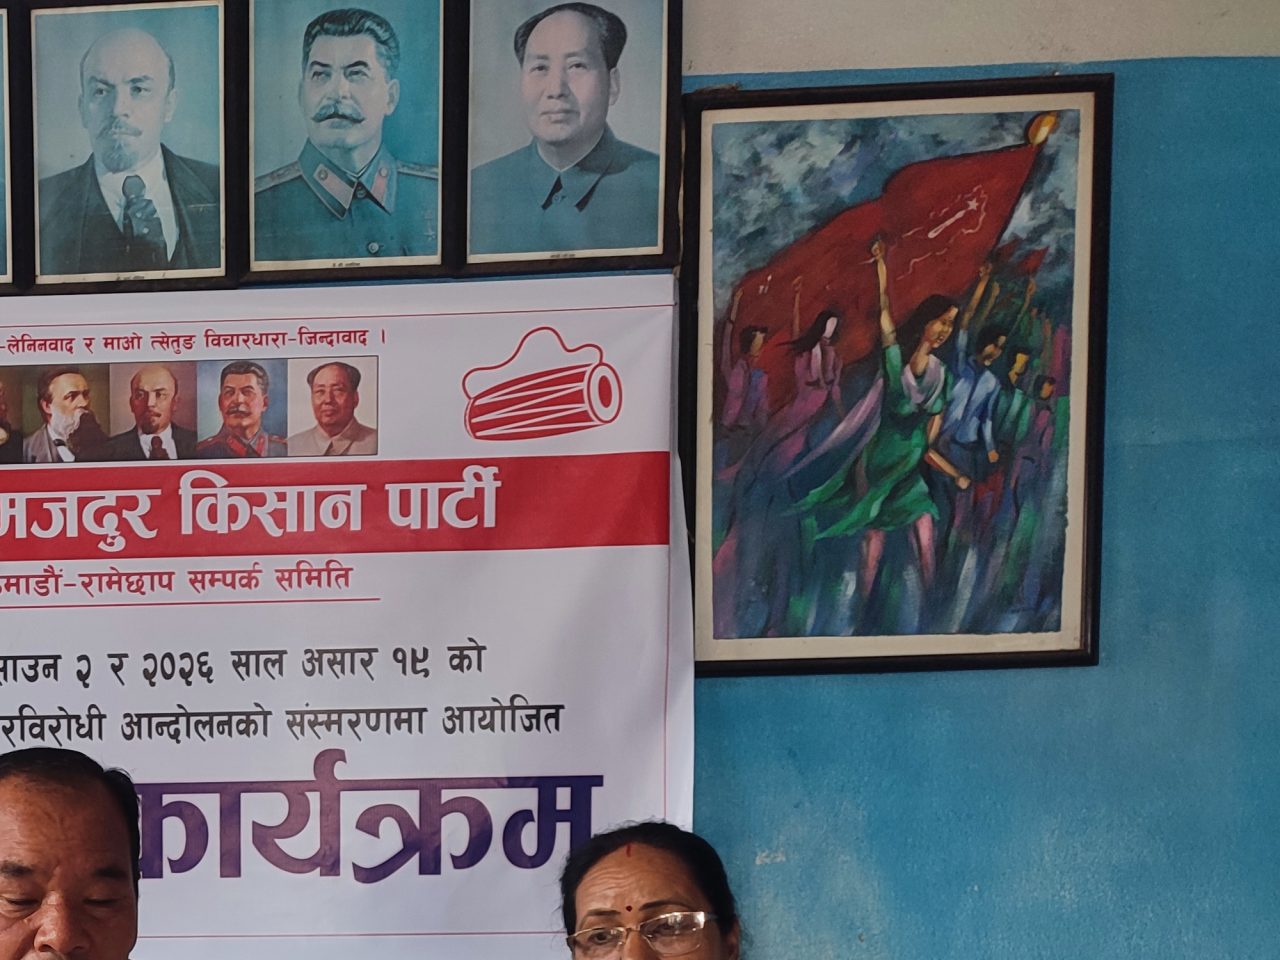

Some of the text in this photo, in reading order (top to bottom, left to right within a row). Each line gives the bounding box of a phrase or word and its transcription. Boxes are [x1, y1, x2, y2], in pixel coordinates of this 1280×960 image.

[83, 337, 96, 354] र
[103, 332, 143, 352] माओ
[150, 331, 197, 355] त्सेतुङ
[180, 469, 368, 538] किसान
[385, 465, 503, 530] पार्टी
[188, 562, 263, 594] सम्पर्क
[275, 559, 354, 592] समिति
[76, 654, 92, 690] २
[107, 653, 130, 687] र
[142, 651, 215, 688] २०२६
[230, 649, 289, 682] साल
[302, 648, 380, 682] असार
[392, 646, 431, 680] १९
[447, 637, 488, 675] को
[121, 703, 273, 745] आन्दोलनको
[285, 703, 429, 742] संस्मरणमा
[443, 694, 567, 736] आयोजित
